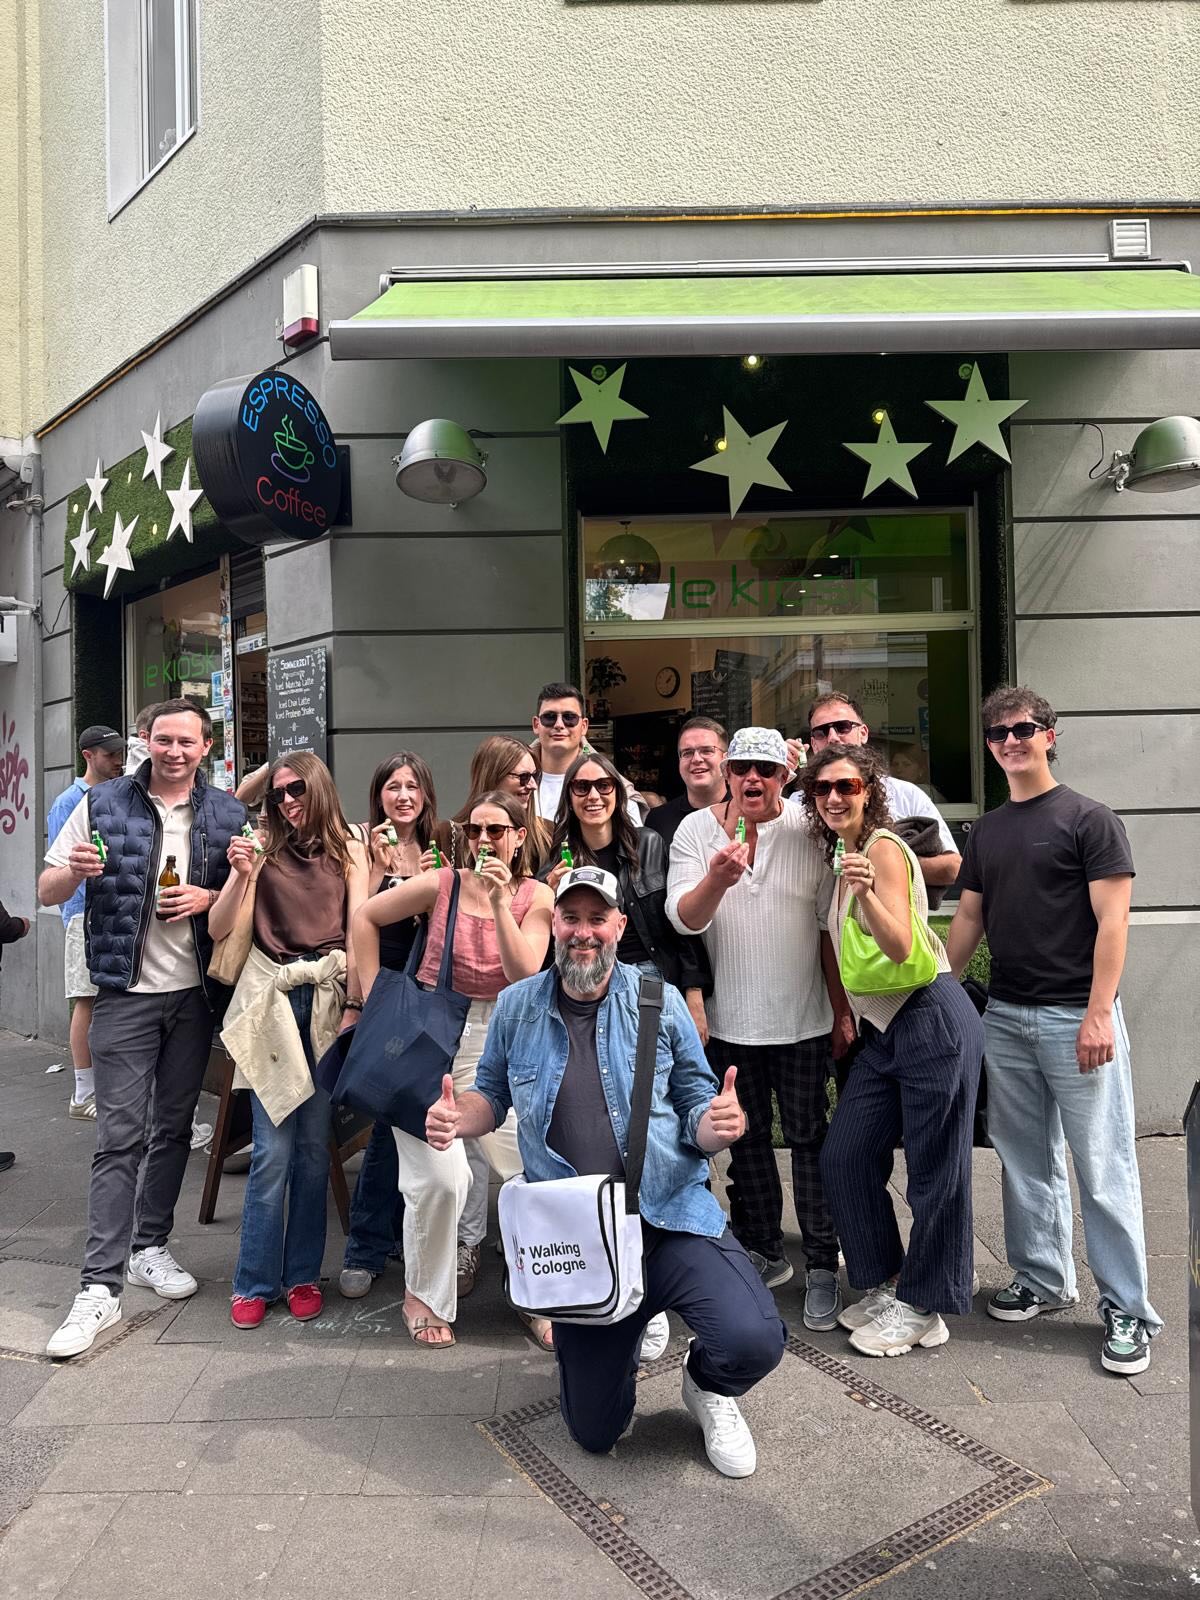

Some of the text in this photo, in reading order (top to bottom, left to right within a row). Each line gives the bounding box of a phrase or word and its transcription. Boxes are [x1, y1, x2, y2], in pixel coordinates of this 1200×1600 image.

[242, 377, 336, 468] ESPRESSO
[256, 476, 327, 528] Coffee
[669, 560, 880, 609] le kiosk
[143, 639, 217, 688] le kiosk
[281, 735, 308, 746] Iced Latte
[529, 1242, 581, 1259] Walking
[532, 1259, 586, 1275] Cologne
